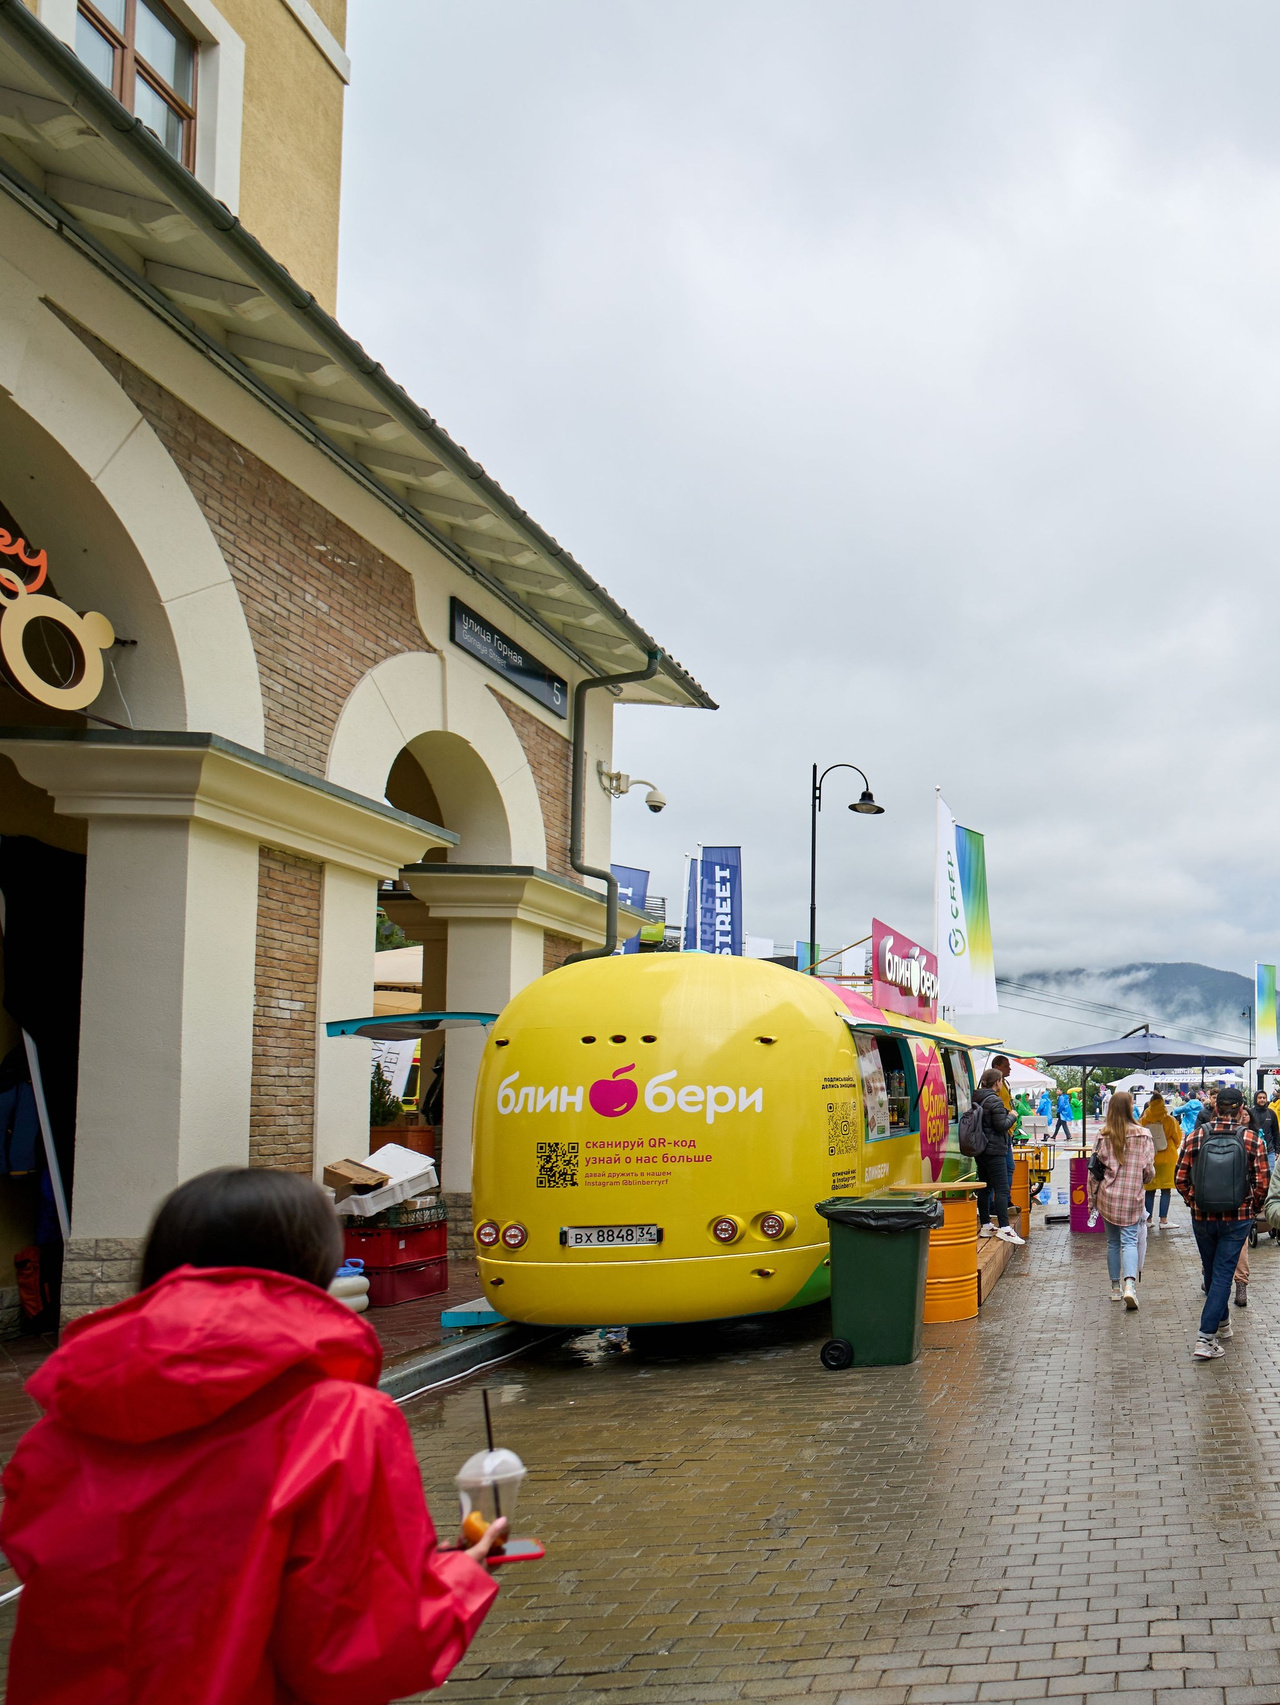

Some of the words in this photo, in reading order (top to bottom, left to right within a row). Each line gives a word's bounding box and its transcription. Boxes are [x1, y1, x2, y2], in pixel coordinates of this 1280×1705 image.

[462, 614, 491, 643] улица
[494, 635, 523, 666] Горная
[462, 630, 488, 655] Gornaya
[488, 648, 507, 668] Street
[553, 681, 561, 705] 5
[881, 935, 911, 988] блин
[920, 955, 940, 1008] бери
[497, 1070, 584, 1115] блин
[644, 1069, 763, 1125] бери
[585, 1138, 644, 1151] сканируй
[648, 1138, 697, 1149] QR-код
[585, 1154, 621, 1167] узнай
[624, 1156, 632, 1164] о
[636, 1155, 658, 1164] нас
[662, 1153, 713, 1164] больше
[584, 1180, 621, 1188] Instagram
[622, 1179, 669, 1187] @blinberryrf
[607, 1171, 639, 1179] дружить
[575, 1232, 593, 1244] ВХ
[597, 1228, 635, 1243] 8848
[638, 1227, 653, 1238] 34
